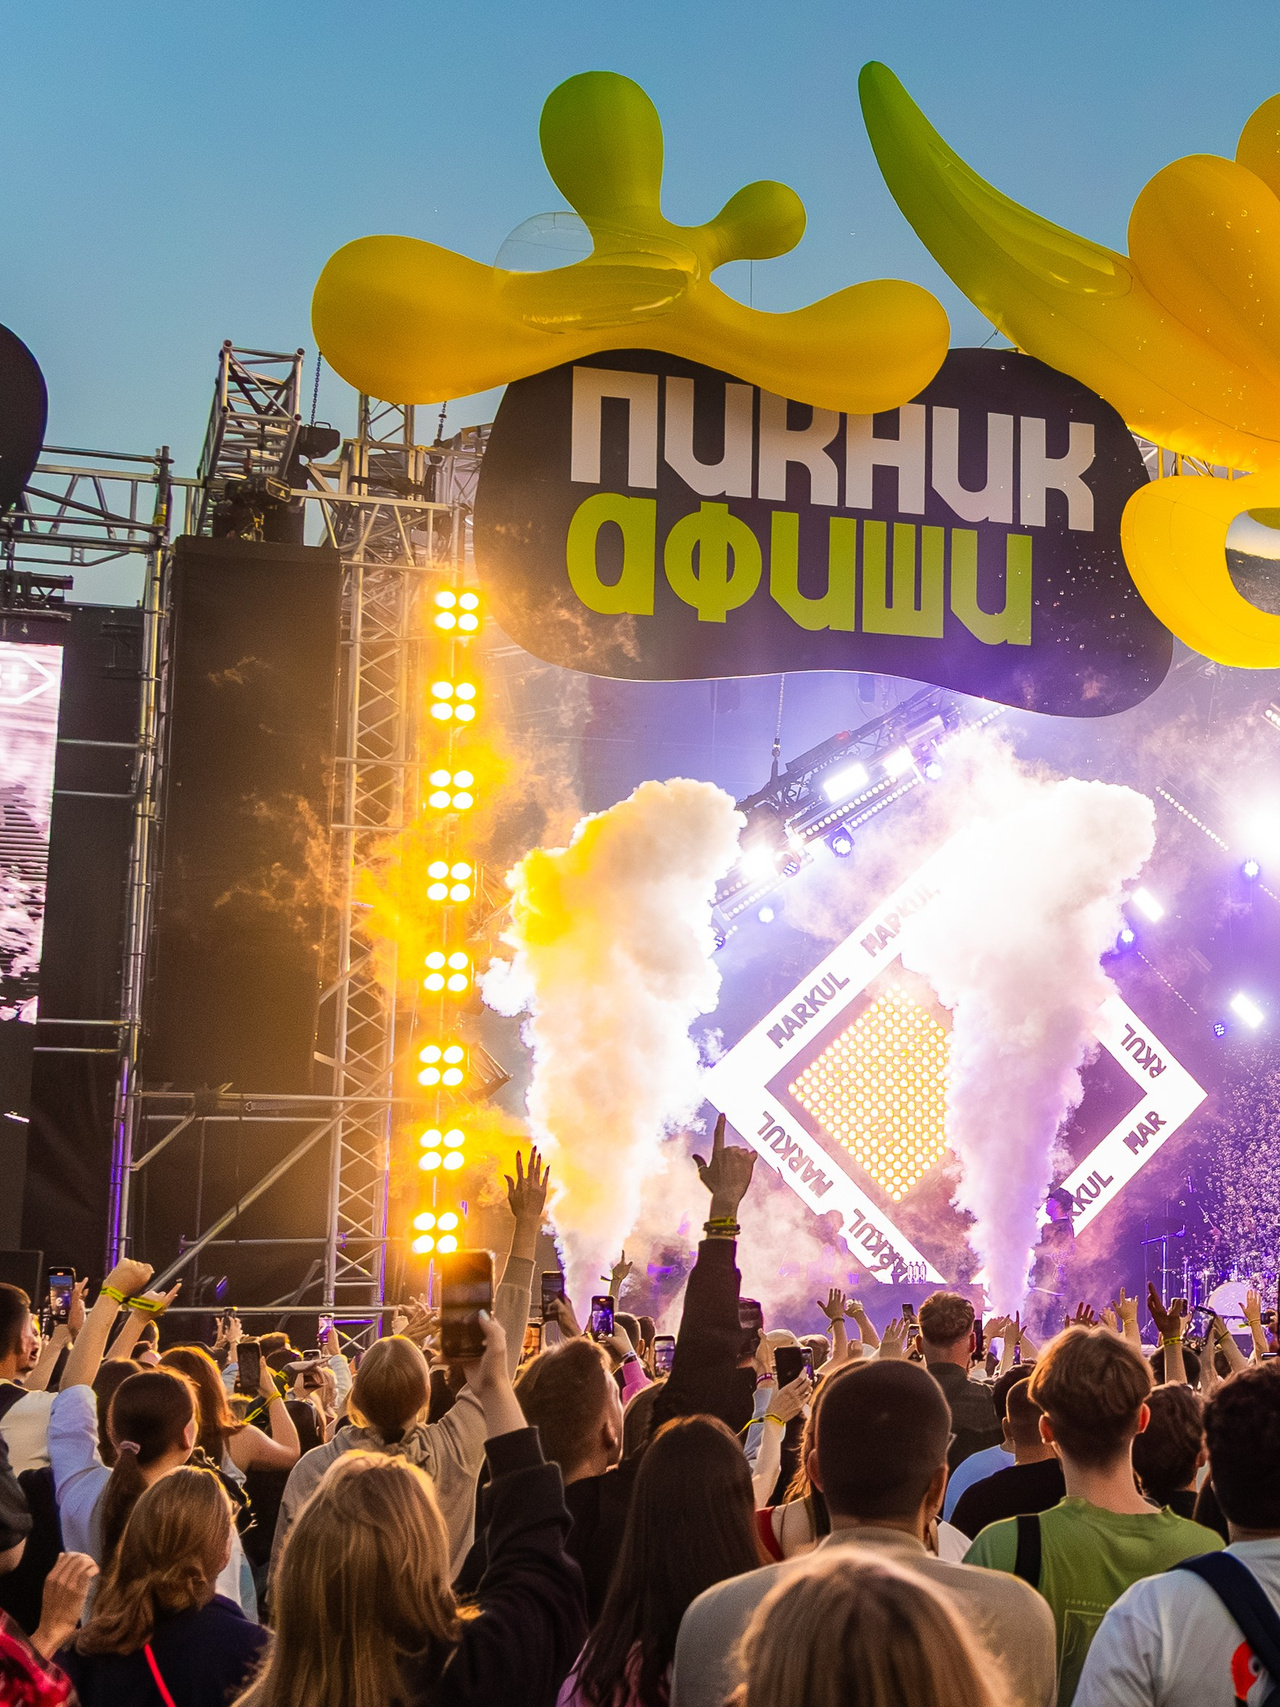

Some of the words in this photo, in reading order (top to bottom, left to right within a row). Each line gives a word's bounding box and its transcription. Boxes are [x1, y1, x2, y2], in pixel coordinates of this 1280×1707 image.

[766, 972, 850, 1049] MARKUL
[757, 1111, 834, 1198] MARKUL
[1123, 1111, 1167, 1156] MAR
